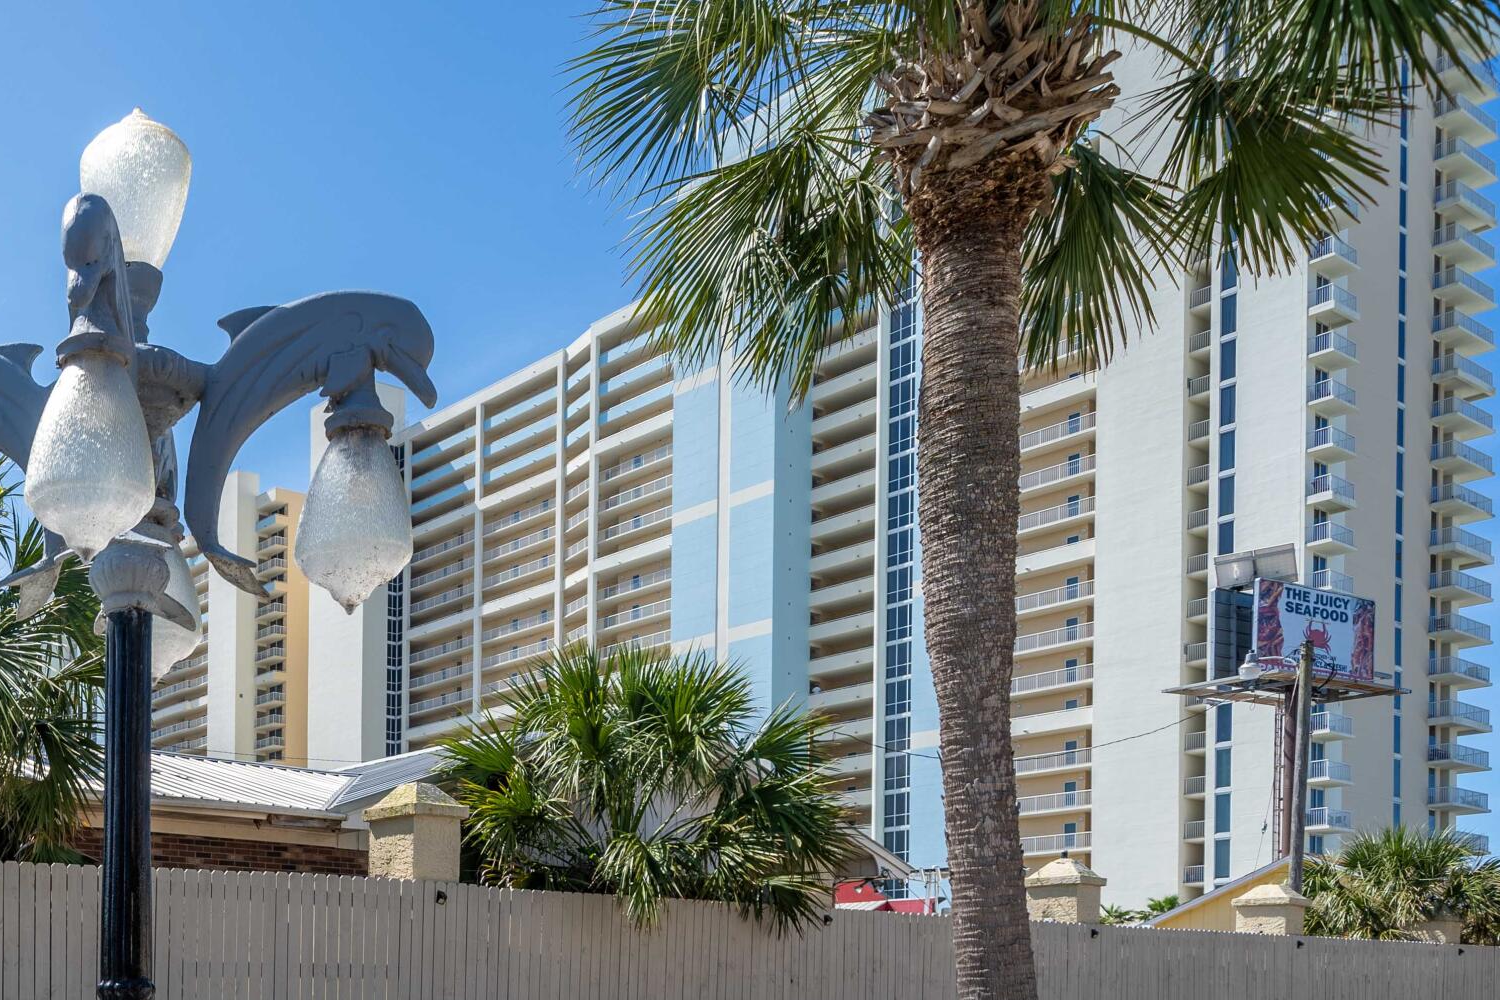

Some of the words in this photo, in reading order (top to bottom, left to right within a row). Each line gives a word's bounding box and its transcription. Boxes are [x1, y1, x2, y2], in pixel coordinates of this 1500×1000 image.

[1285, 586, 1311, 603] THE
[1313, 593, 1350, 610] JUICY
[1285, 601, 1349, 623] SEAFOOD
